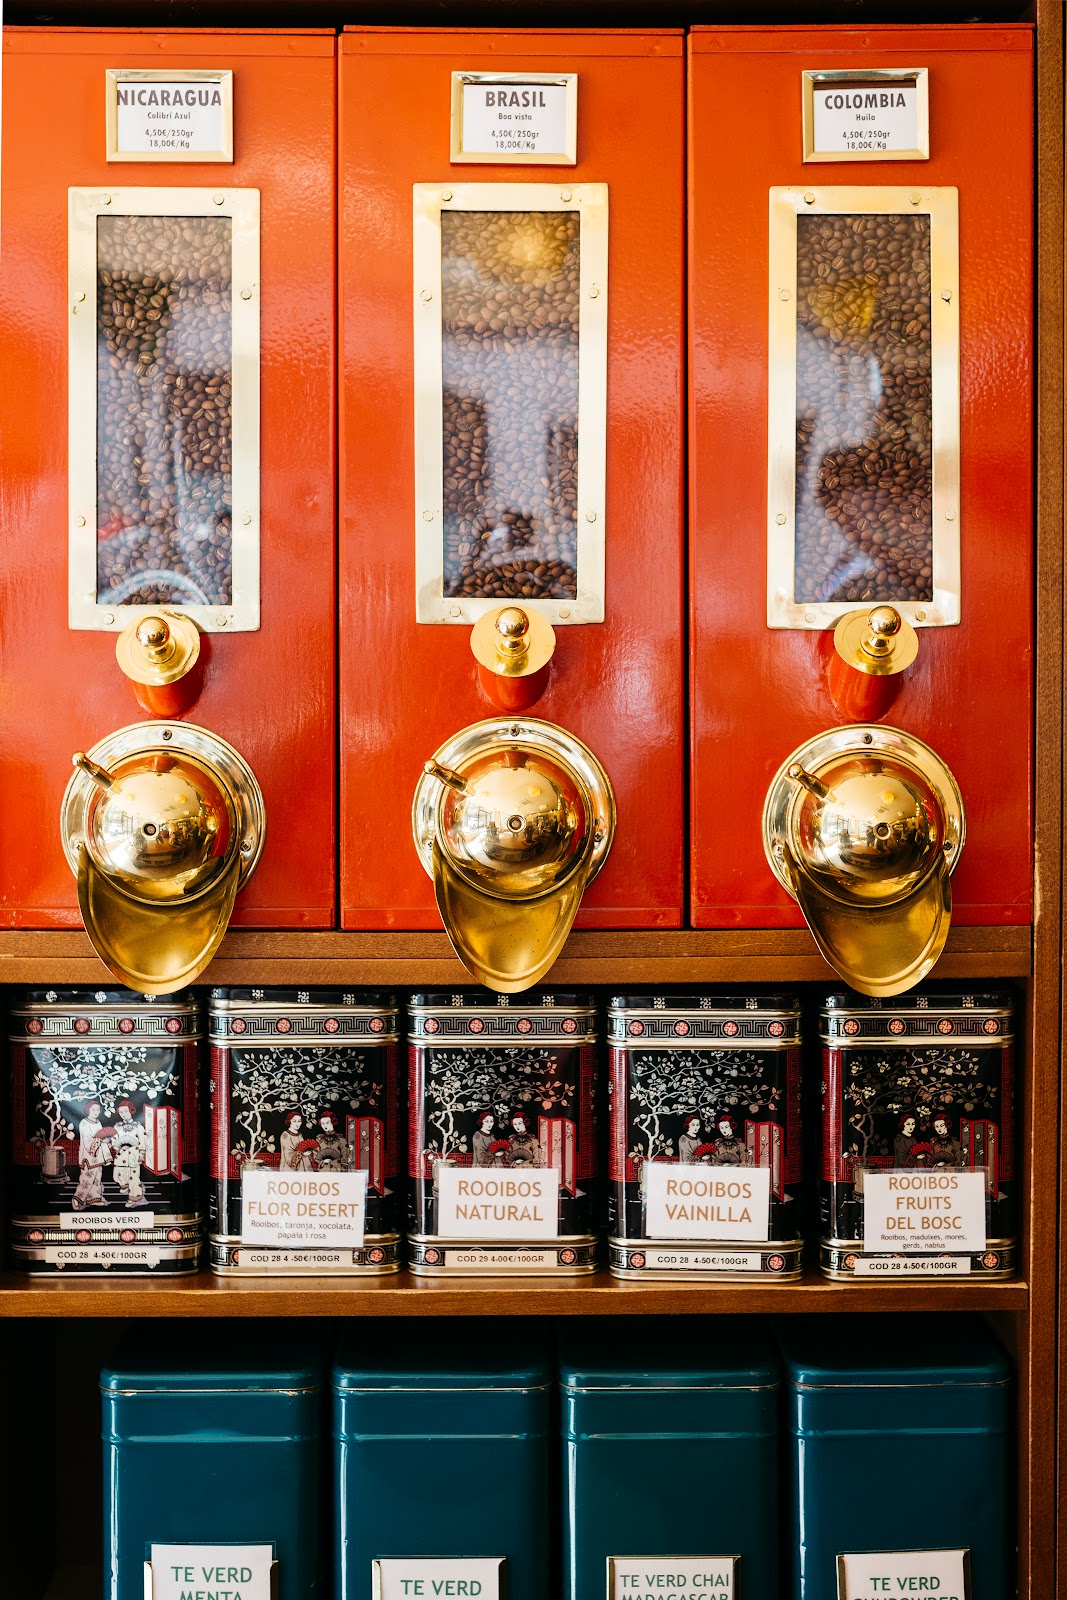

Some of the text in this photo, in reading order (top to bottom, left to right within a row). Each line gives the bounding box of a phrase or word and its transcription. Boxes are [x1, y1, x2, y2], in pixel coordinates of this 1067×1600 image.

[117, 89, 222, 107] NICARAGUA
[485, 91, 546, 108] BRASIL
[824, 93, 907, 110] COLOMBIA
[174, 111, 191, 120] Azul
[498, 112, 532, 121] Boa vista
[855, 113, 876, 121] Huila
[145, 129, 194, 138] 4,50€/250gr
[491, 130, 540, 139] 4,50€/250gr
[842, 131, 891, 140] 4,50€/250gr
[149, 139, 190, 149] 18,00€/Kg
[495, 140, 536, 150] 18,00€/Kg
[847, 141, 887, 150] 18,00€/Kg
[267, 1181, 340, 1196] ROOIBOS
[458, 1180, 542, 1197] ROOIBOS
[666, 1179, 752, 1199] ROOIBOS
[888, 1176, 959, 1190] ROOIBOS
[248, 1201, 359, 1218] FLOR DESERT
[896, 1196, 952, 1210] FRUITS
[455, 1204, 544, 1221] NATURAL
[665, 1204, 752, 1223] VAINILLA
[71, 1216, 141, 1224] ROOIBOS VERD
[250, 1219, 354, 1231] Rooibos, taronja, xocolata,
[886, 1216, 962, 1230] DEL BOSC
[57, 1251, 77, 1259] COD
[79, 1251, 89, 1259] 28
[170, 1566, 252, 1583] TE VERD
[619, 1573, 729, 1588] TE VERD CHAI
[400, 1579, 482, 1596] TE VERD
[869, 1576, 940, 1591] TE VERD
